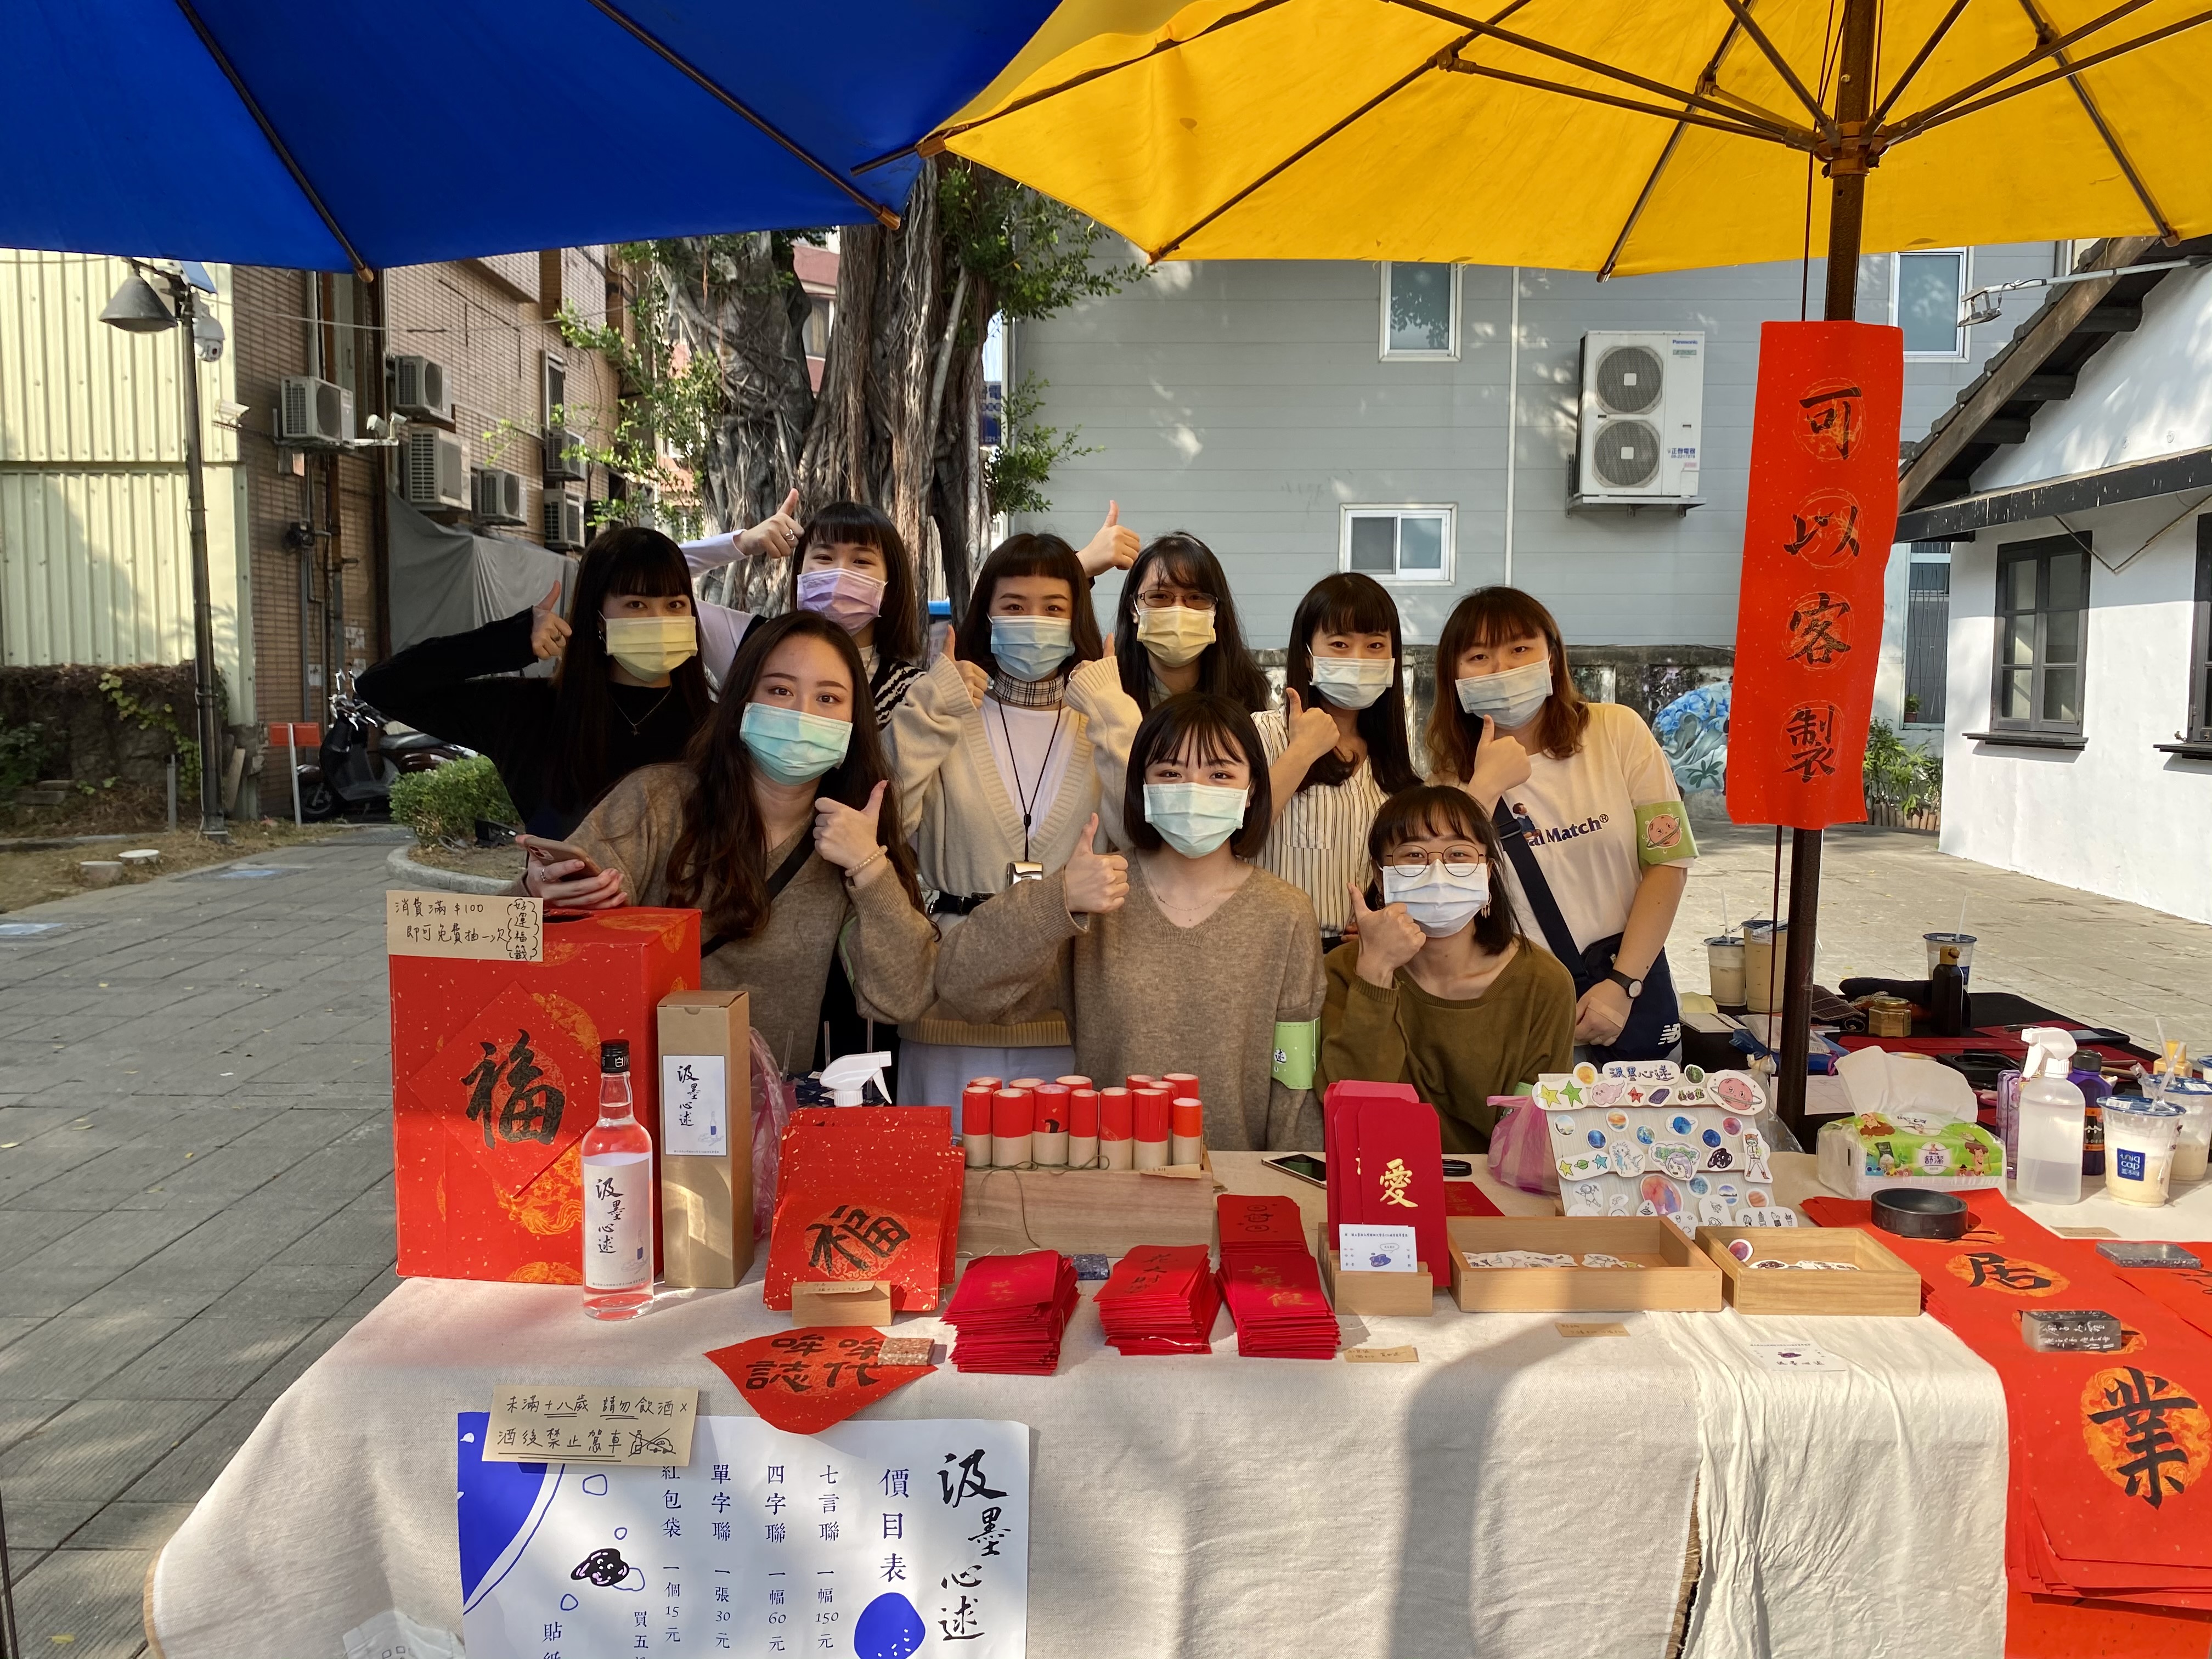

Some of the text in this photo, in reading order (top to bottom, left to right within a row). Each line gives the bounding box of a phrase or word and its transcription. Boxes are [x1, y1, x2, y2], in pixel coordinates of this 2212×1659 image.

[1782, 386, 1863, 783] 可以客製
[459, 1029, 566, 1151] 福
[677, 1064, 699, 1127] 汲墨心述
[1379, 1158, 1419, 1207] 愛
[1925, 1155, 1944, 1164] 舒潔
[2121, 1161, 2140, 1171] cap
[595, 1177, 625, 1254] 汲墨心述
[805, 1204, 911, 1277] 福
[498, 1427, 622, 1453] 酒後禁止駕車
[659, 1465, 682, 1538] 紅包袋
[710, 1464, 731, 1543] 單字聯
[764, 1464, 787, 1543] 四字聯
[818, 1464, 840, 1542] 七言聯
[878, 1468, 910, 1583] 價目表
[936, 1448, 1011, 1641] 汲墨心述
[633, 1611, 649, 1659] 買五
